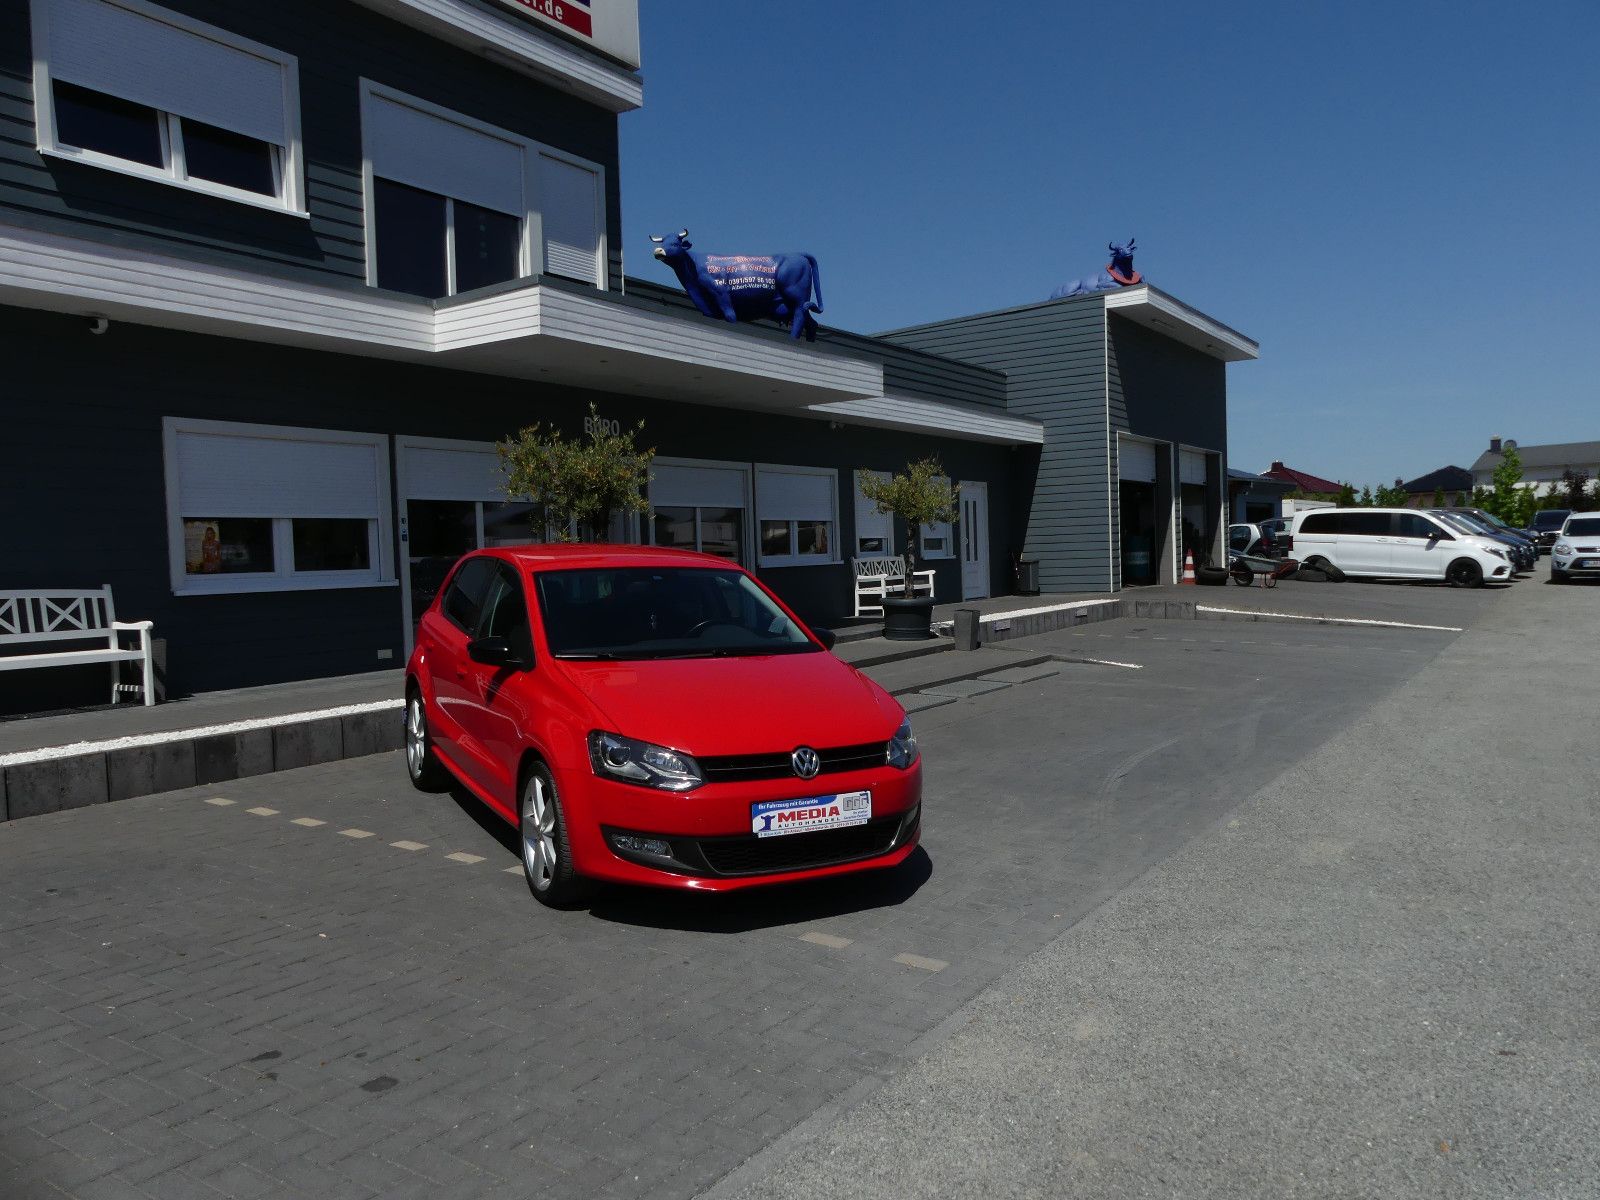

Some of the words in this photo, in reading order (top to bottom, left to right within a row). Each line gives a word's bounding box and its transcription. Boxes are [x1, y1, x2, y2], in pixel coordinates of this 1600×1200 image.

[523, 0, 563, 20] .de
[778, 806, 841, 823] MEDIA
[778, 817, 841, 829] AUTOHANDEL
